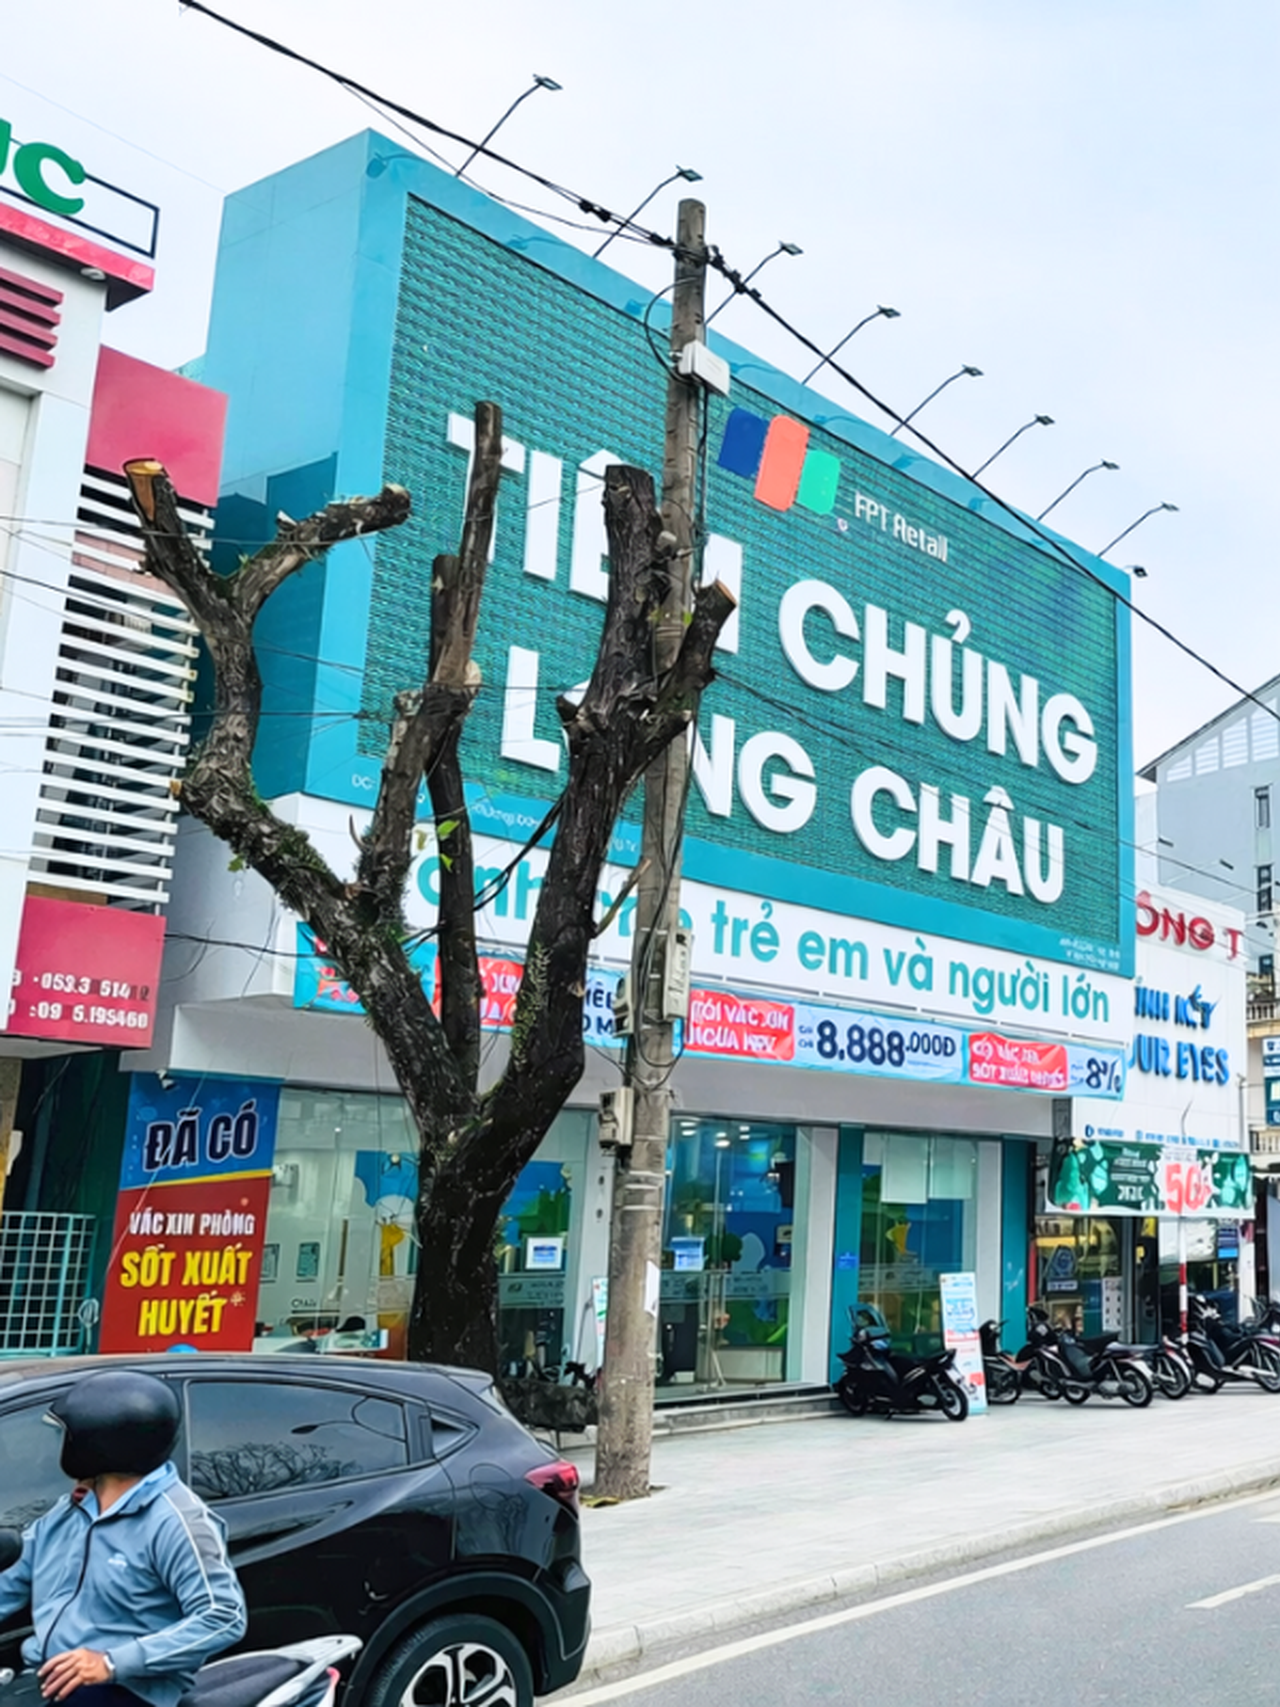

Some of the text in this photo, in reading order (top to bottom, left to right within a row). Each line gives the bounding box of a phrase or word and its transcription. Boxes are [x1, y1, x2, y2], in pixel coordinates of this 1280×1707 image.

[0, 118, 85, 215] C
[855, 490, 948, 563] FPT Retail
[778, 579, 1097, 785] CHỦNG
[501, 645, 1064, 903] LNG CHÂU
[711, 900, 780, 962] trẻ
[798, 930, 868, 980] em
[883, 937, 933, 992] và
[949, 961, 1049, 1014] người
[1062, 973, 1109, 1023] lớn
[143, 1098, 258, 1172] ĐÃ CÓ
[165, 1213, 195, 1235] XIN
[199, 1209, 255, 1236] PHÒNG
[120, 1242, 252, 1288] SỐT XUẤT
[138, 1290, 227, 1336] HUYẾT
